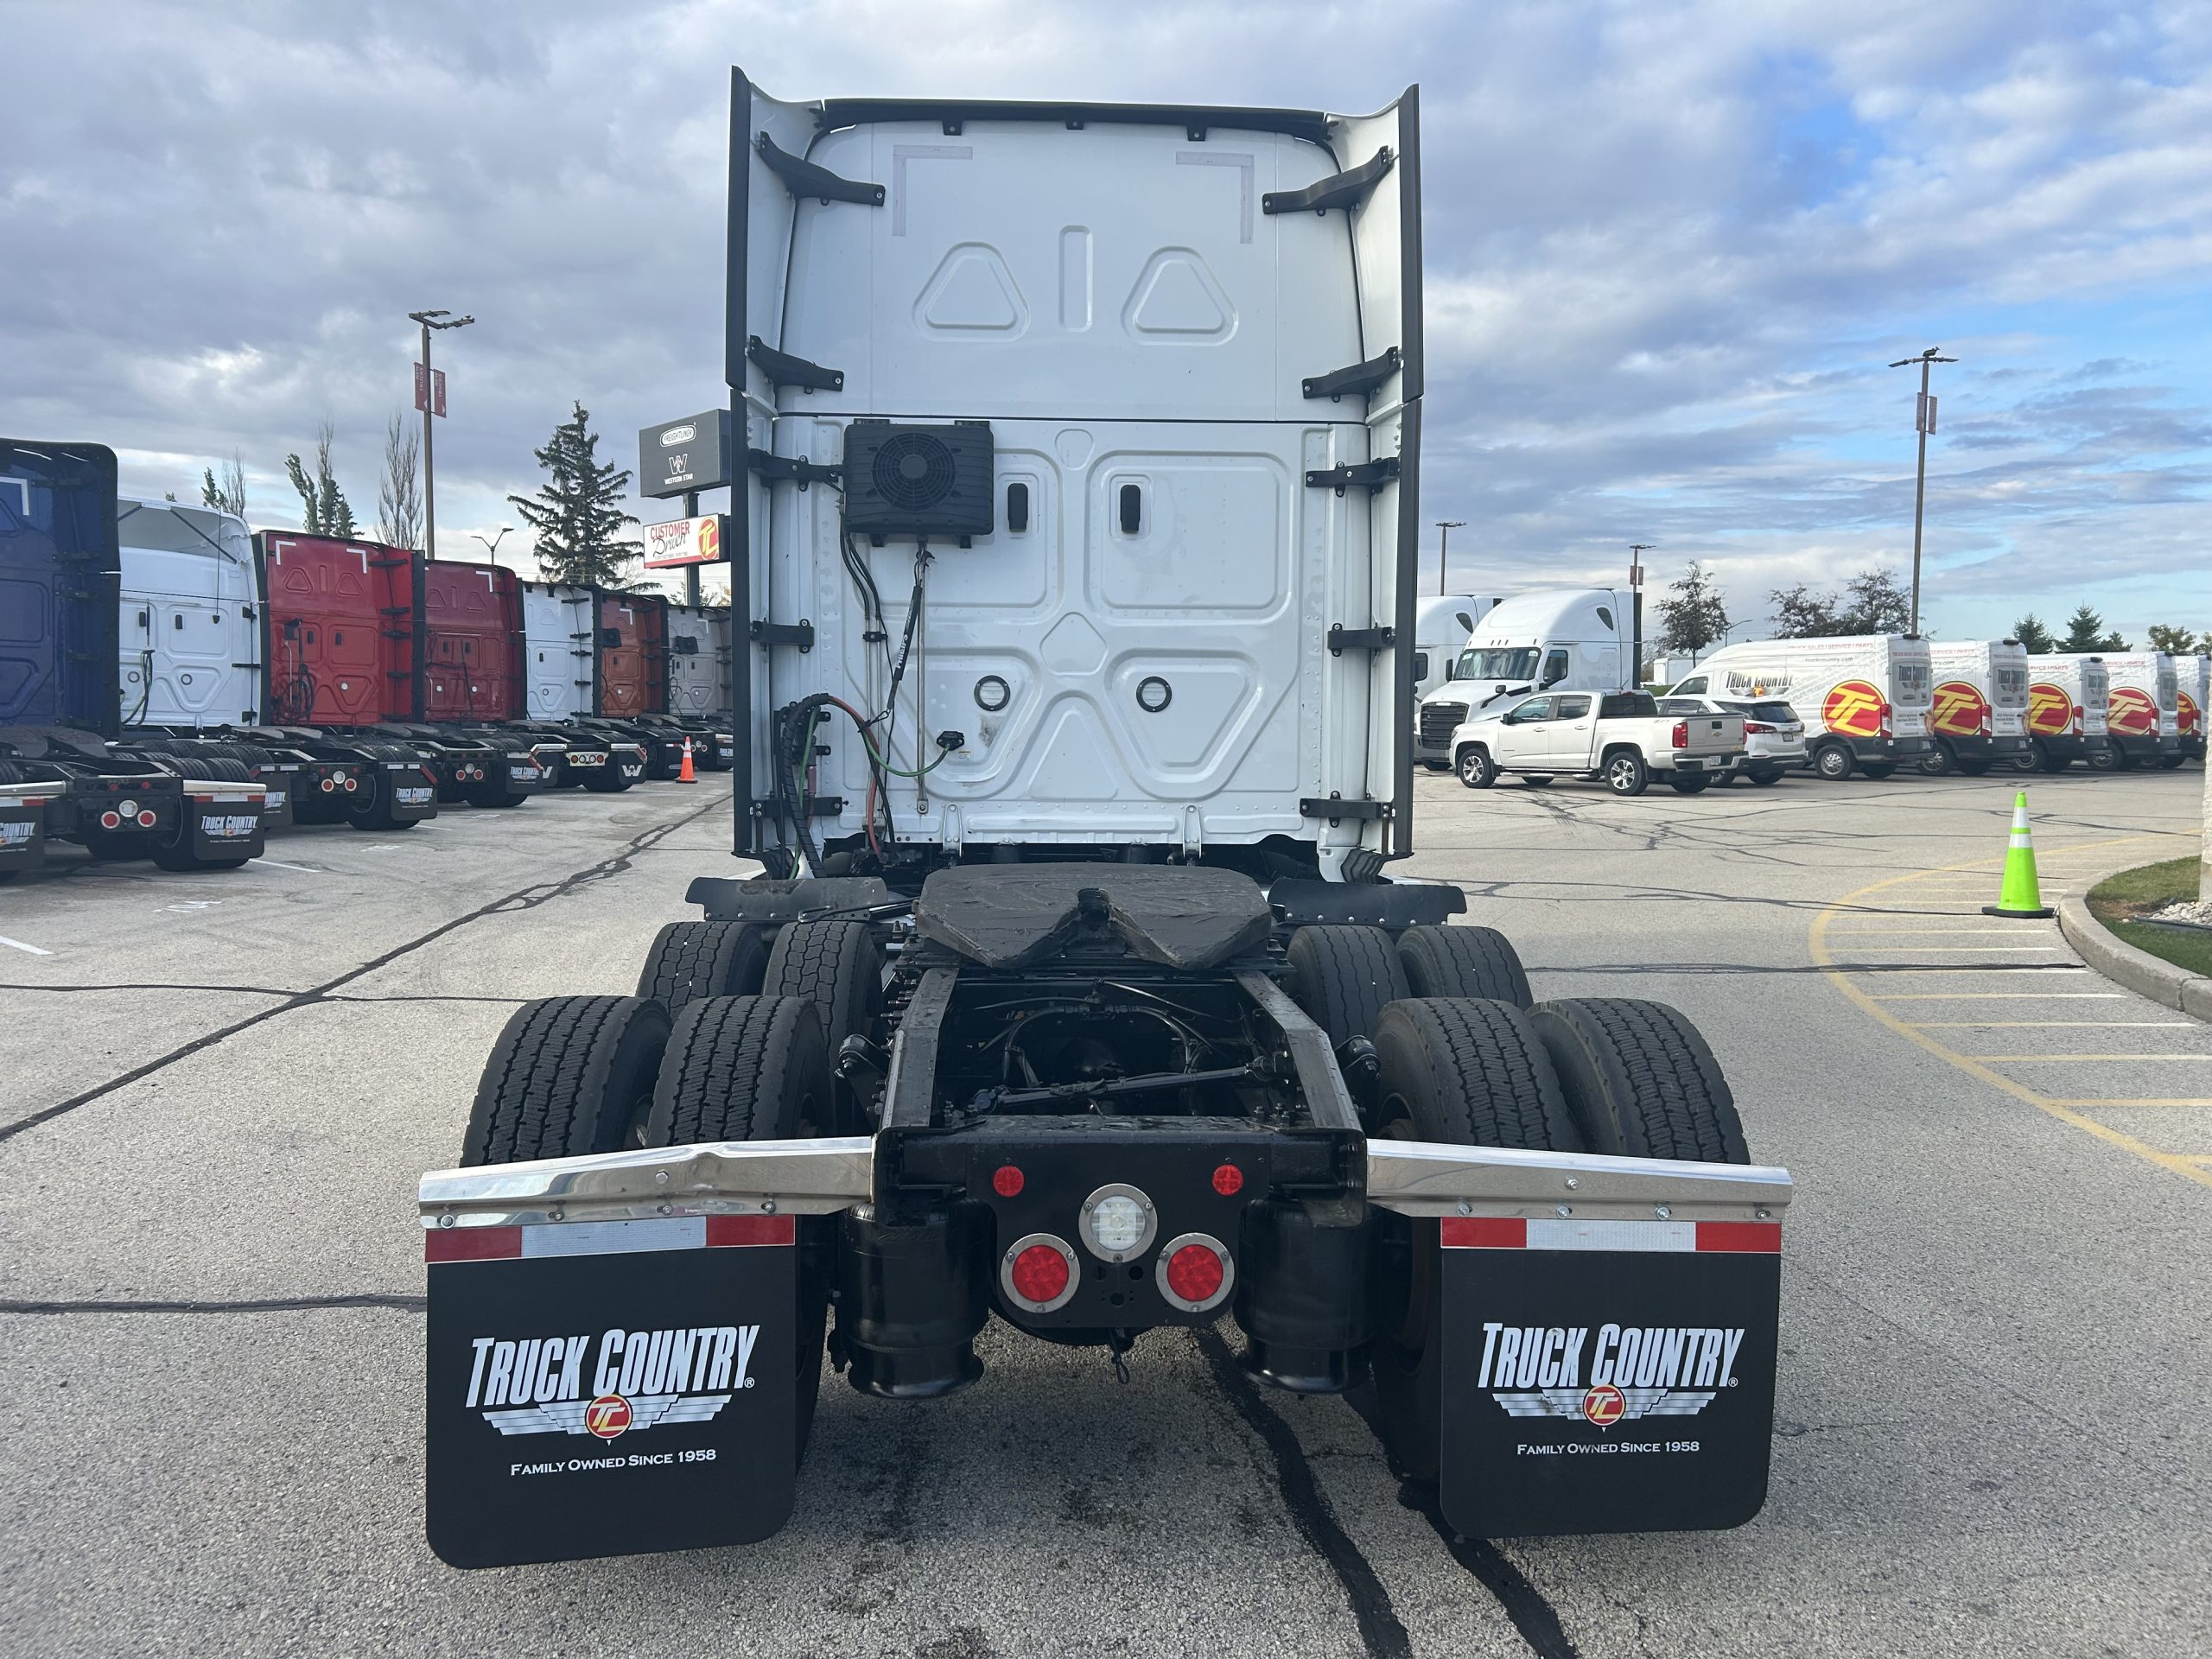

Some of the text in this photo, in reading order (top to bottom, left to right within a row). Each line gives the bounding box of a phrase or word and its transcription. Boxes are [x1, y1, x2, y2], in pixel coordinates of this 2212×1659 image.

[664, 429, 692, 442] FREIGHTLINER
[664, 476, 683, 485] WESTERN
[650, 521, 690, 540] CUSTOMER
[1726, 671, 1752, 689] TRUCK
[1827, 687, 1881, 737] TC
[200, 815, 258, 830] TRUCK COUNTRY
[1478, 1322, 1745, 1389] TRUCK COUNTRY
[465, 1325, 760, 1408] TRUCK COUNTRY
[1517, 1441, 1700, 1455] FAMILY OWNED SINCE 1958
[511, 1449, 716, 1476] FAMILY OWNED SINCE 1958
